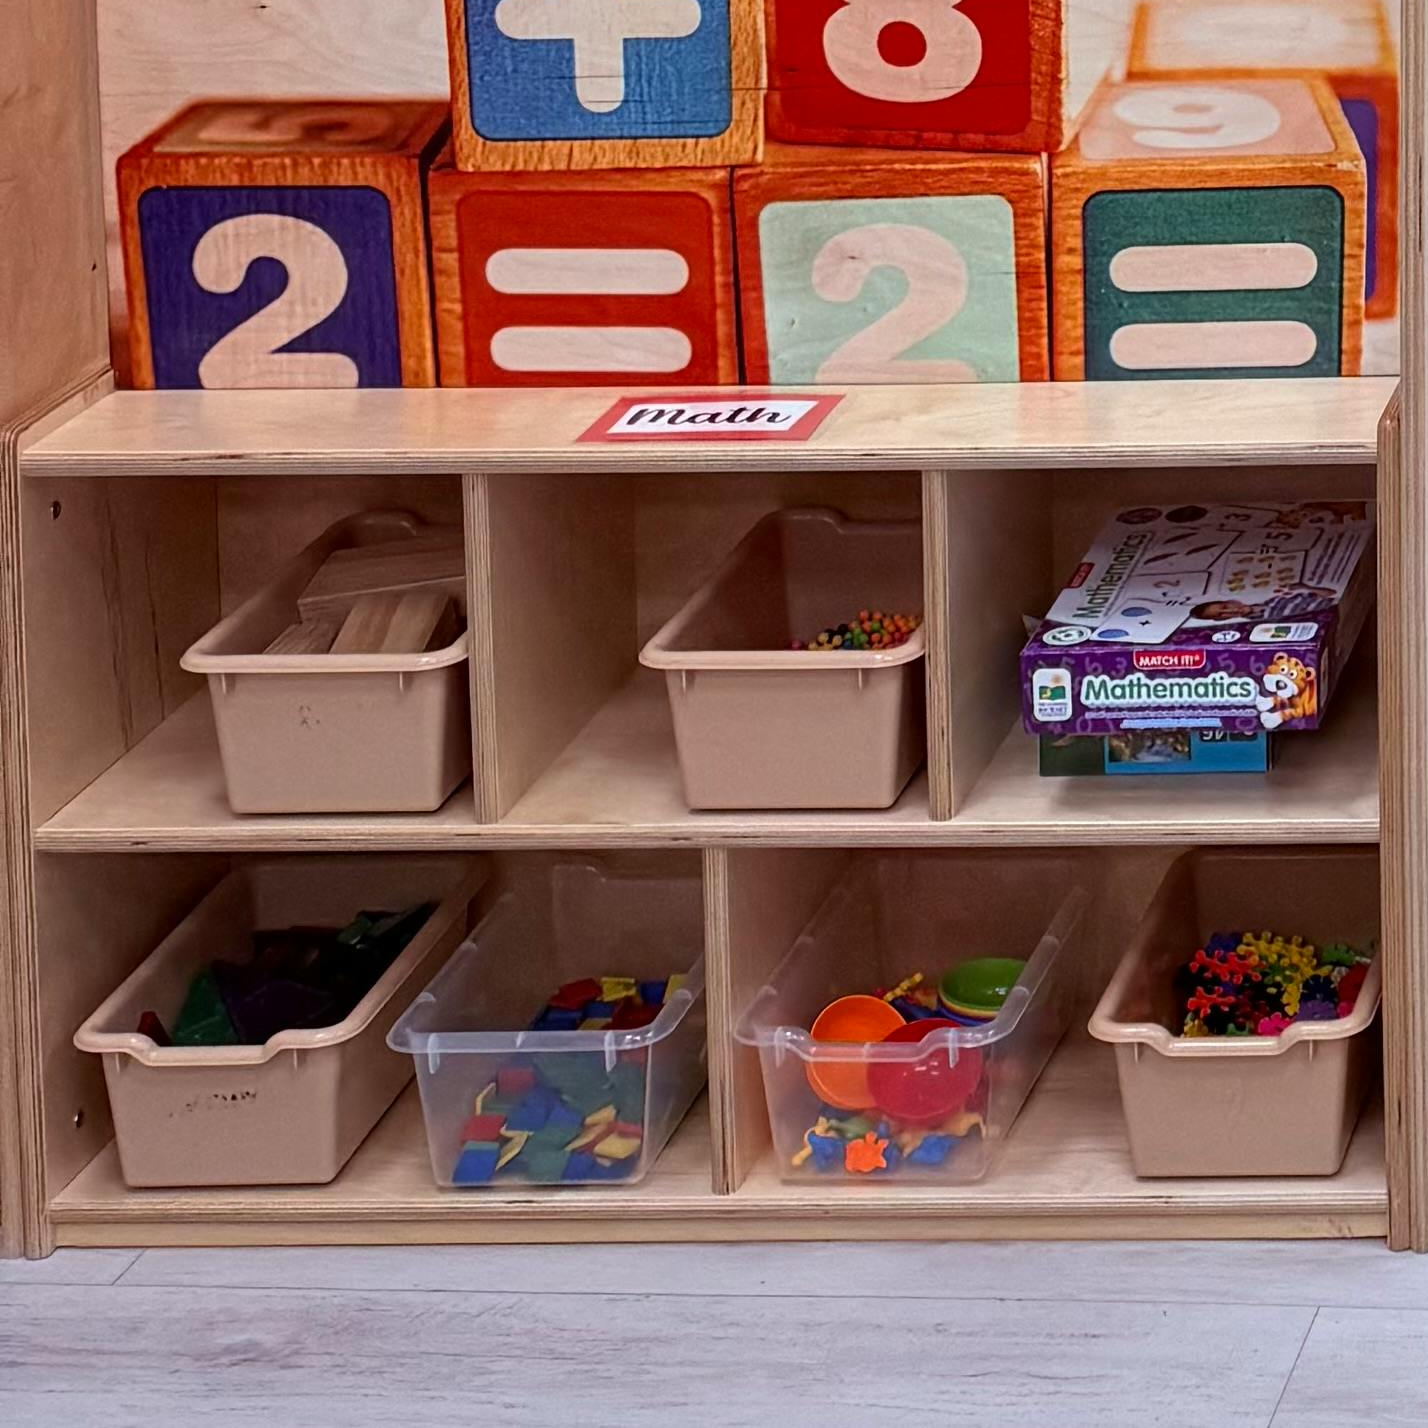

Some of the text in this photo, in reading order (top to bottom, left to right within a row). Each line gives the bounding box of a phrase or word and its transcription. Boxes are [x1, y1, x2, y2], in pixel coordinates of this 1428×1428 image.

[189, 213, 361, 390] 2
[810, 222, 980, 383] 2
[626, 407, 792, 426] Math
[1072, 530, 1148, 619] Mathematics
[1085, 676, 1252, 701] Mathematics
[1138, 655, 1178, 666] MATCH
